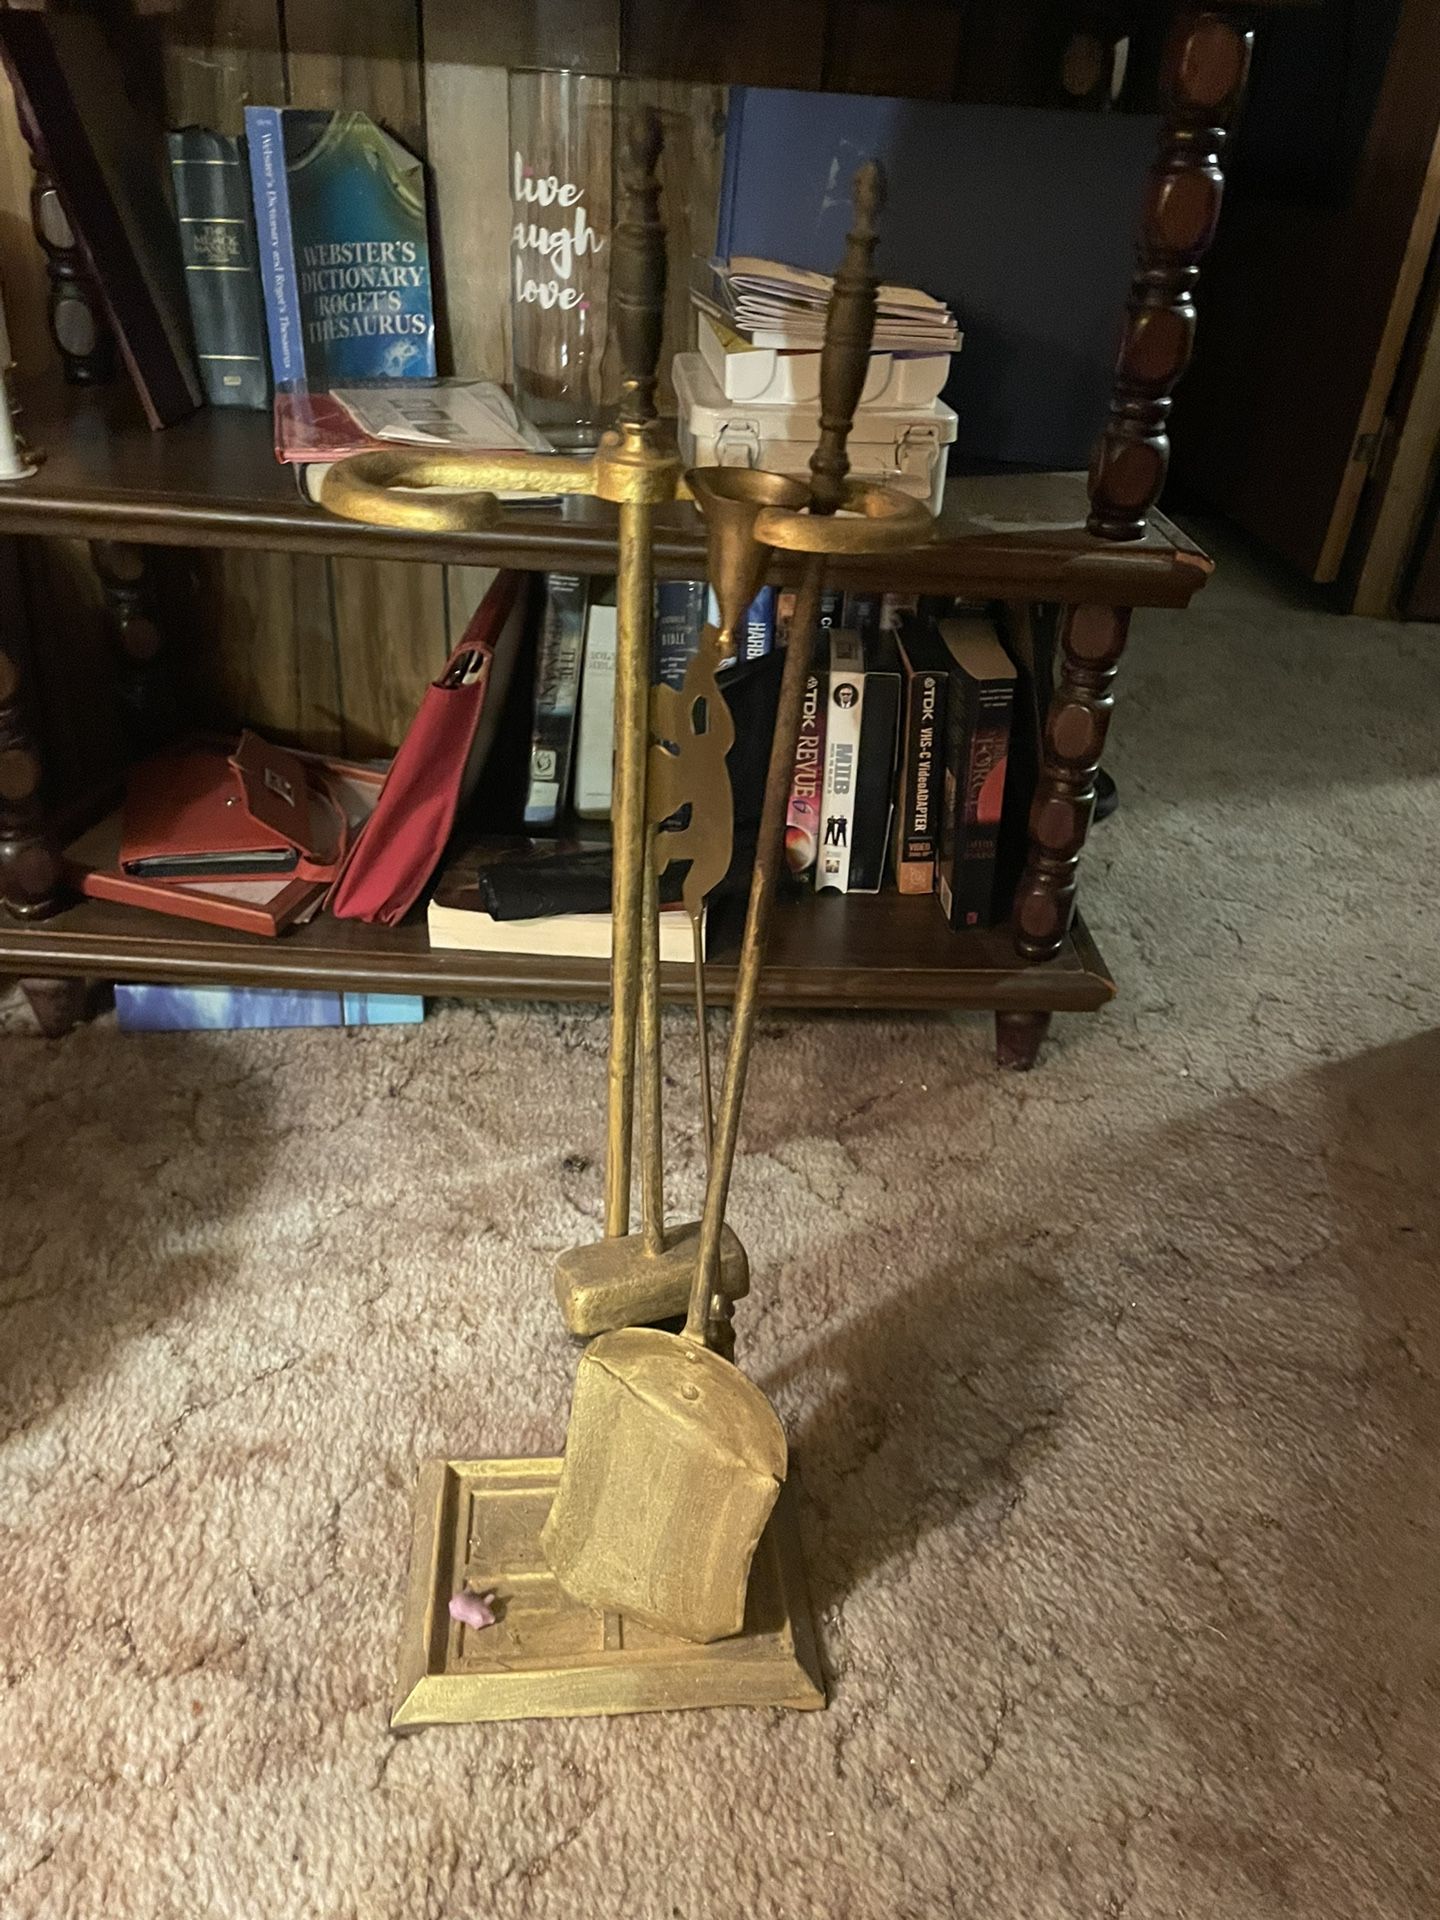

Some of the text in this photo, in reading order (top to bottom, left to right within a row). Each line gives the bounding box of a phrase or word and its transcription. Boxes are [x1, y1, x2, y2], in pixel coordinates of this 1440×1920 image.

[514, 151, 585, 207] live
[304, 241, 416, 267] WEBSTER'S
[511, 206, 604, 280] augh
[302, 266, 425, 293] DICTIONARY
[515, 254, 585, 310] love
[319, 290, 402, 317] ROGET'S
[309, 314, 427, 343] THESAURUS
[921, 686, 936, 721] TDK
[793, 688, 820, 799] TDK REVUE
[919, 727, 934, 760] VHS-C
[833, 743, 854, 797] MIIB
